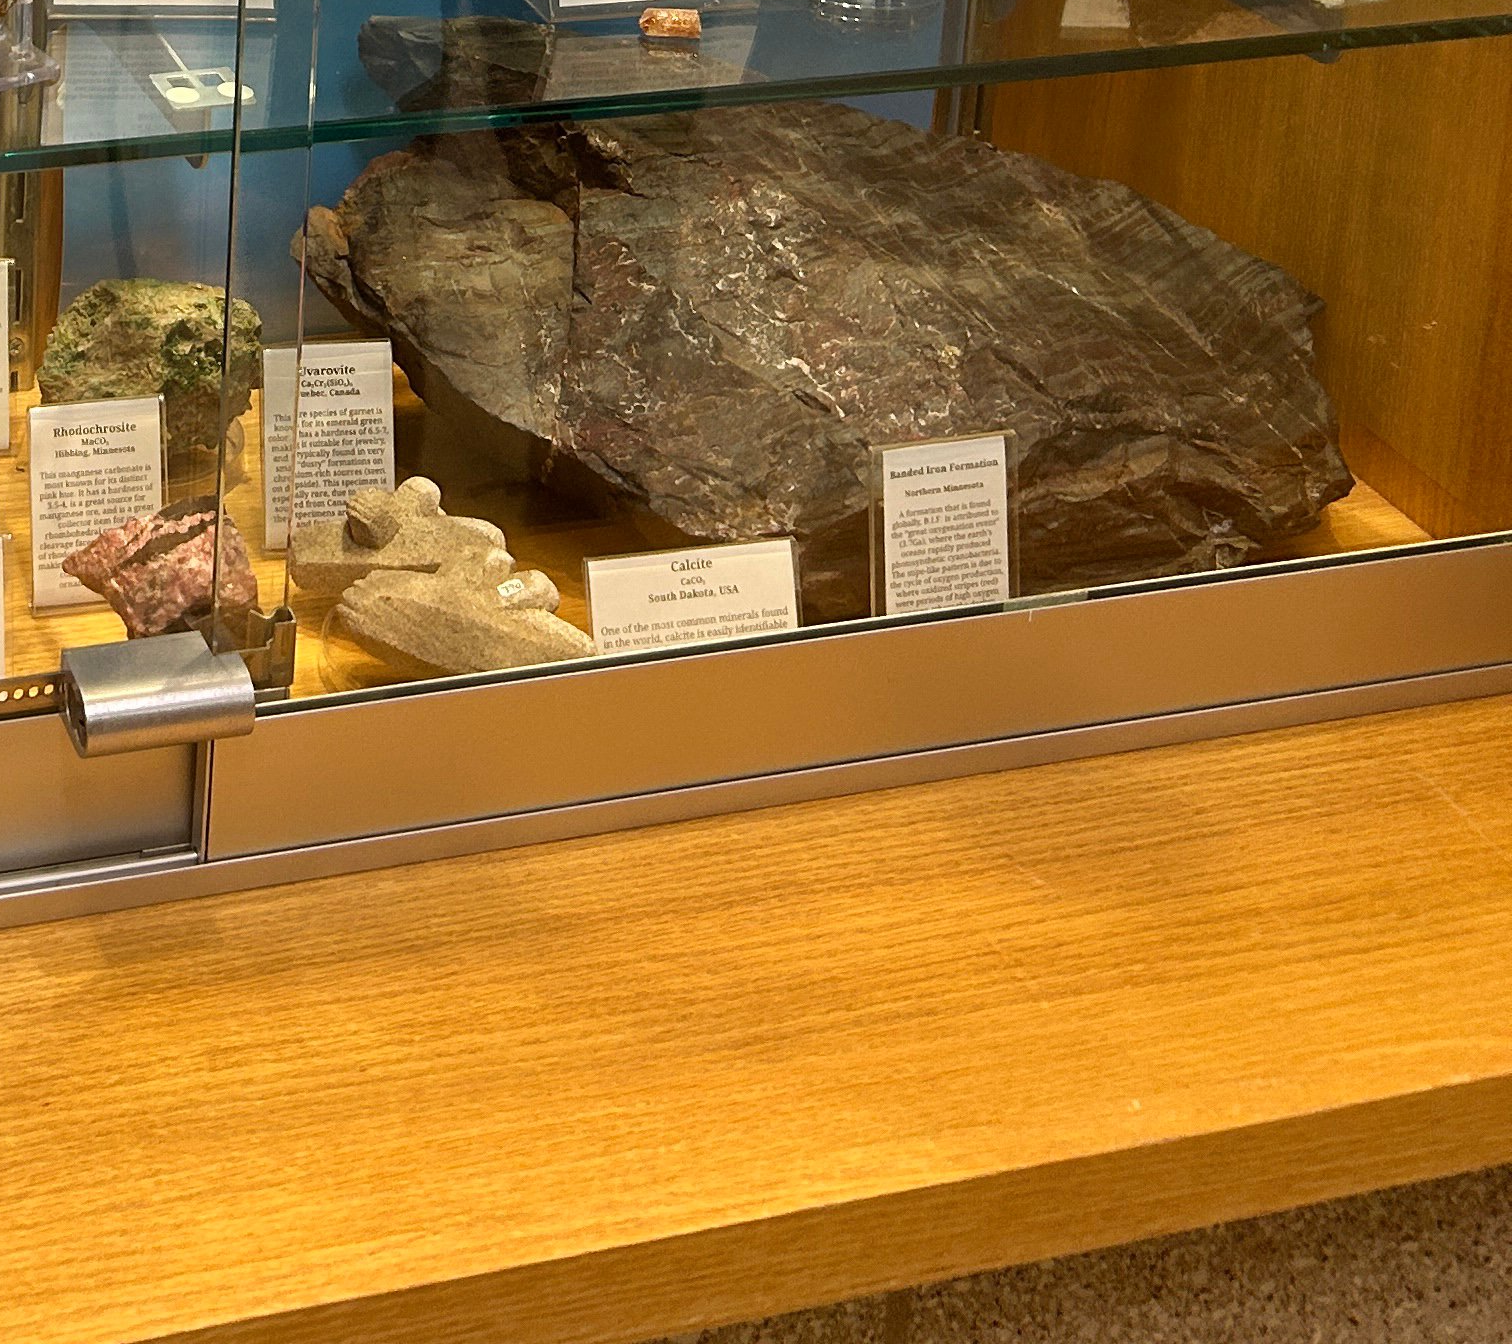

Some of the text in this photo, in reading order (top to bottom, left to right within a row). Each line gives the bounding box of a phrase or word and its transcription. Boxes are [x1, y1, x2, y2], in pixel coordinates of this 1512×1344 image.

[329, 387, 360, 397] Canada
[53, 421, 136, 436] Rhodochrosite
[889, 458, 998, 479] Banded Iron Formation
[670, 559, 712, 572] Calcite
